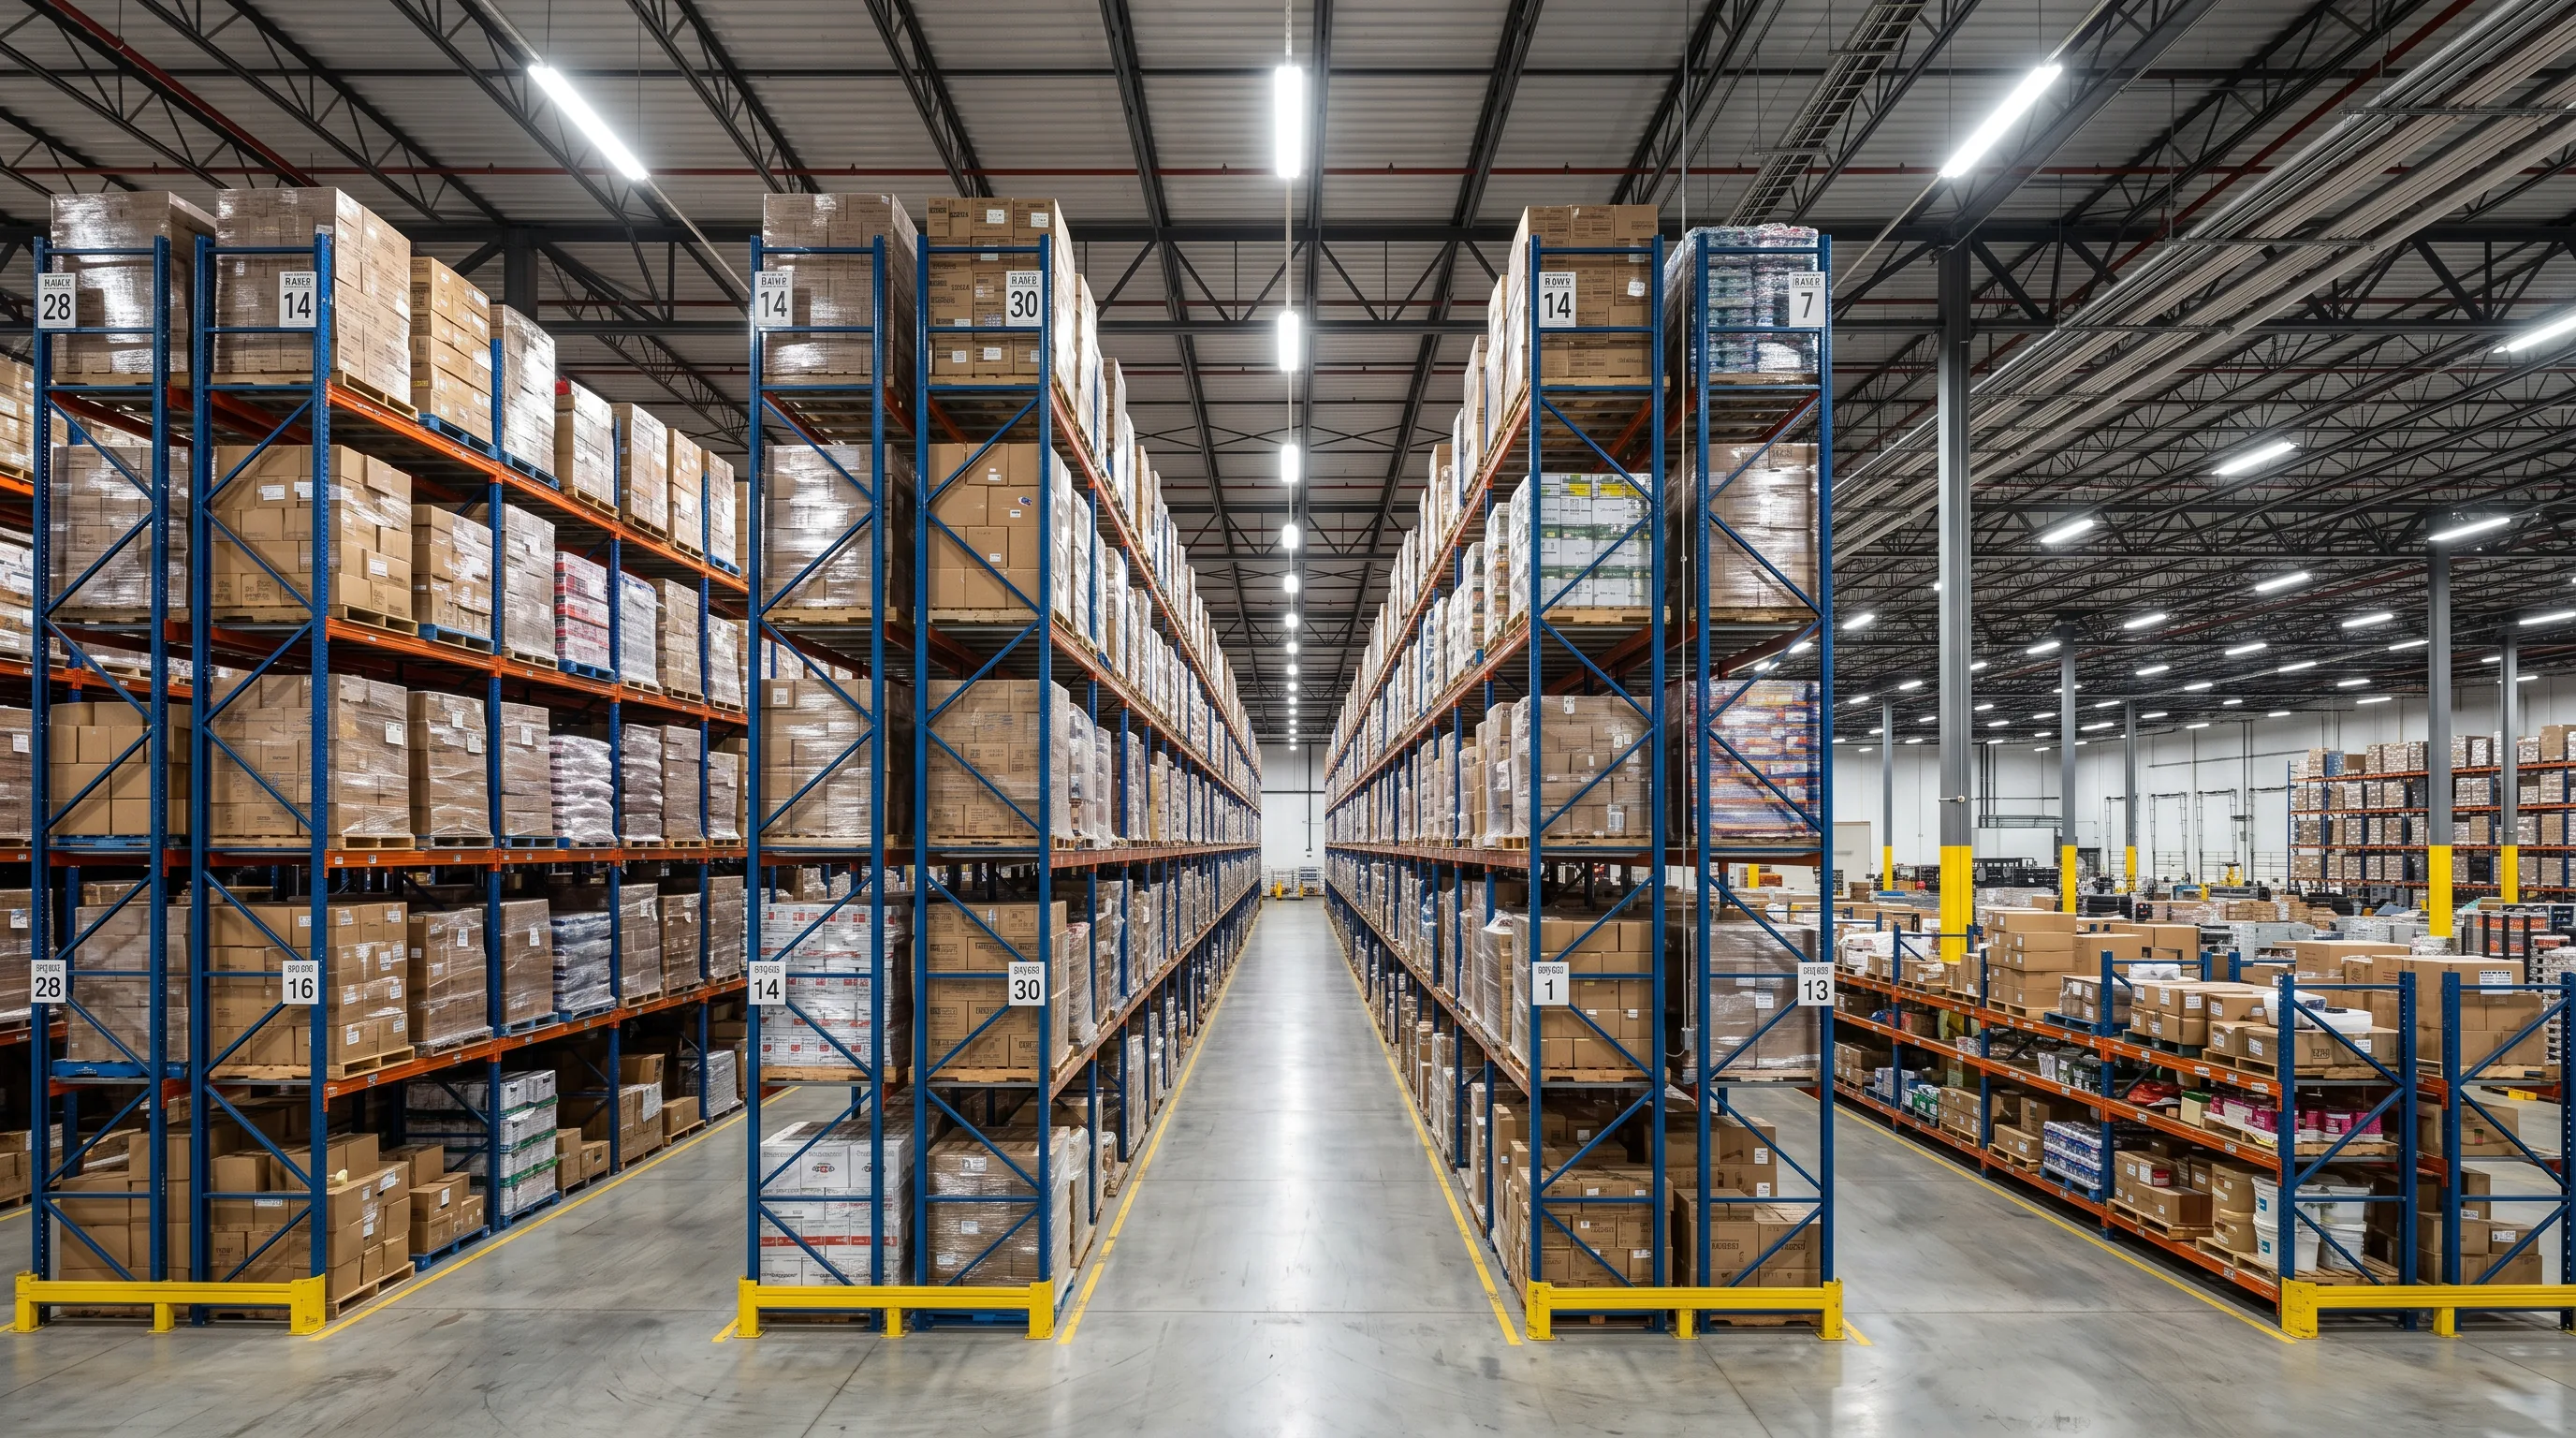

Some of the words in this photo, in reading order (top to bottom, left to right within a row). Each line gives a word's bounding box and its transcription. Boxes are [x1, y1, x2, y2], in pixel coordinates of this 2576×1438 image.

[43, 293, 70, 320] 28
[285, 292, 311, 318] 14
[761, 291, 787, 317] 14
[1011, 290, 1037, 317] 30
[1544, 292, 1571, 318] 14
[1801, 292, 1813, 317] 7
[36, 976, 61, 997] 28
[288, 978, 313, 999] 16
[754, 979, 779, 999] 14
[1015, 979, 1040, 1000] 30
[1545, 979, 1552, 1000] 1
[1805, 980, 1828, 1001] 13
